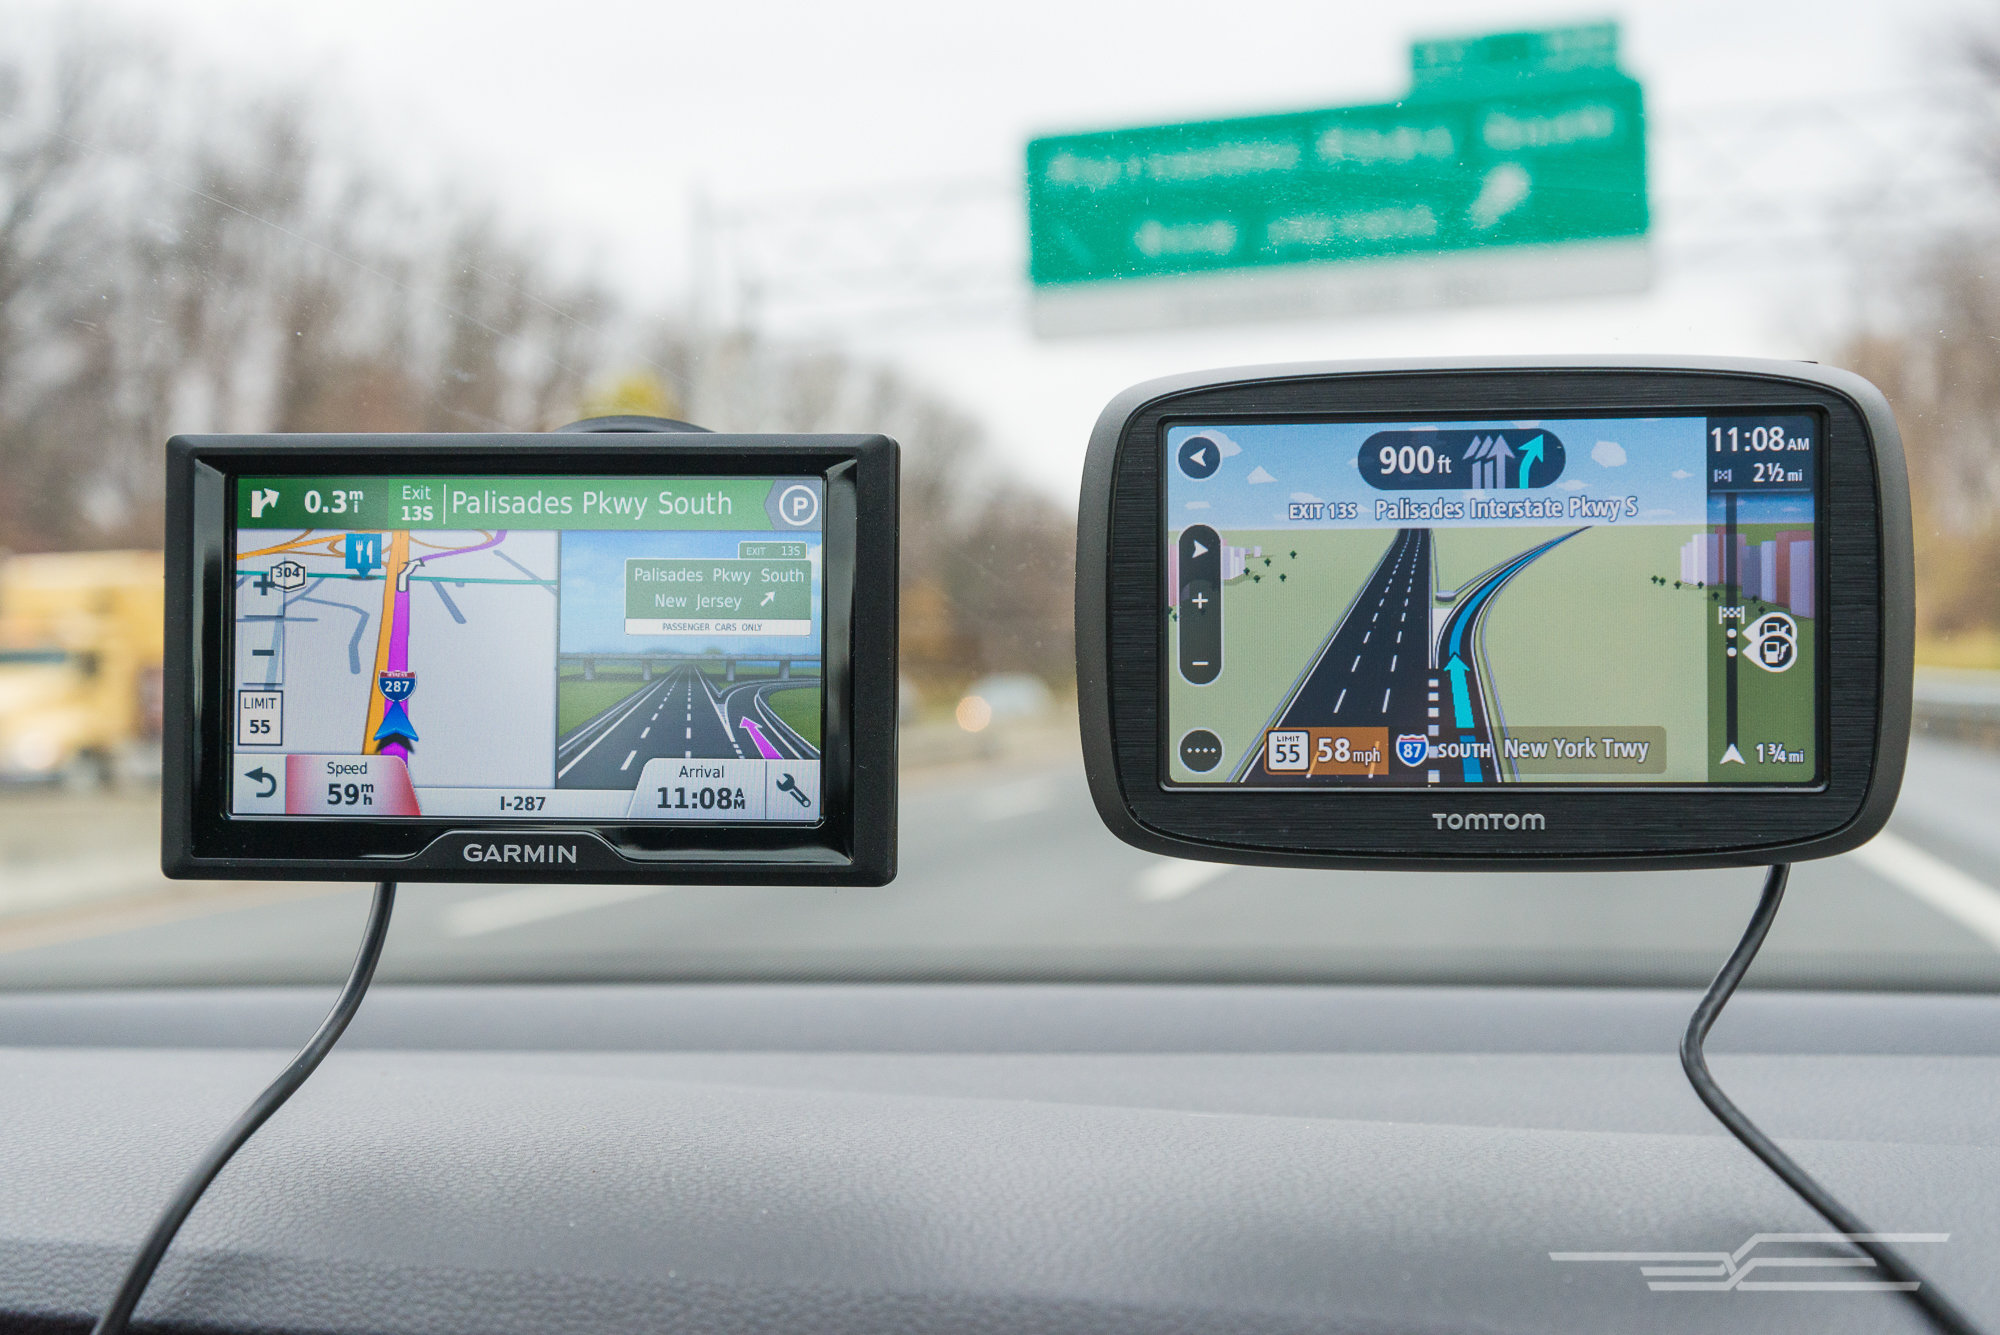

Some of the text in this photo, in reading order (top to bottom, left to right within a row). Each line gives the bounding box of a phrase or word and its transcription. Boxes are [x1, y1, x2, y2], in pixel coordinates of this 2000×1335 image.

[1710, 426, 1810, 452] 11:08 AM
[1379, 446, 1452, 475] 900 ft
[1787, 469, 1802, 482] mi
[402, 485, 432, 500] Exit
[304, 490, 347, 514] 0.3
[452, 490, 732, 520] Palisades Pkwy South
[1289, 496, 1638, 522] EXIT 13S Palisades Interstate Pkwy S
[401, 506, 434, 521] 13S
[746, 546, 800, 556] EXIT 13S
[276, 568, 300, 578] 304
[634, 568, 804, 586] Palisades Pkwy South
[655, 594, 742, 611] New Jersey
[662, 622, 762, 632] PASSENGER CARS ONLY
[385, 680, 410, 692] 287
[244, 697, 276, 710] LIMIT
[250, 720, 271, 734] 55
[1276, 744, 1300, 763] 55
[1316, 738, 1381, 766] 58 mph
[1404, 744, 1422, 758] 87
[1438, 738, 1650, 763] SOUTH New York Trwy
[1788, 749, 1804, 764] mi
[327, 762, 368, 776] Speed
[678, 765, 724, 778] Arrival
[327, 784, 360, 805] 59
[657, 787, 732, 810] 11:08
[500, 796, 546, 811] I-287
[1432, 813, 1546, 831] TOMTOM
[463, 844, 578, 864] GARMIN
